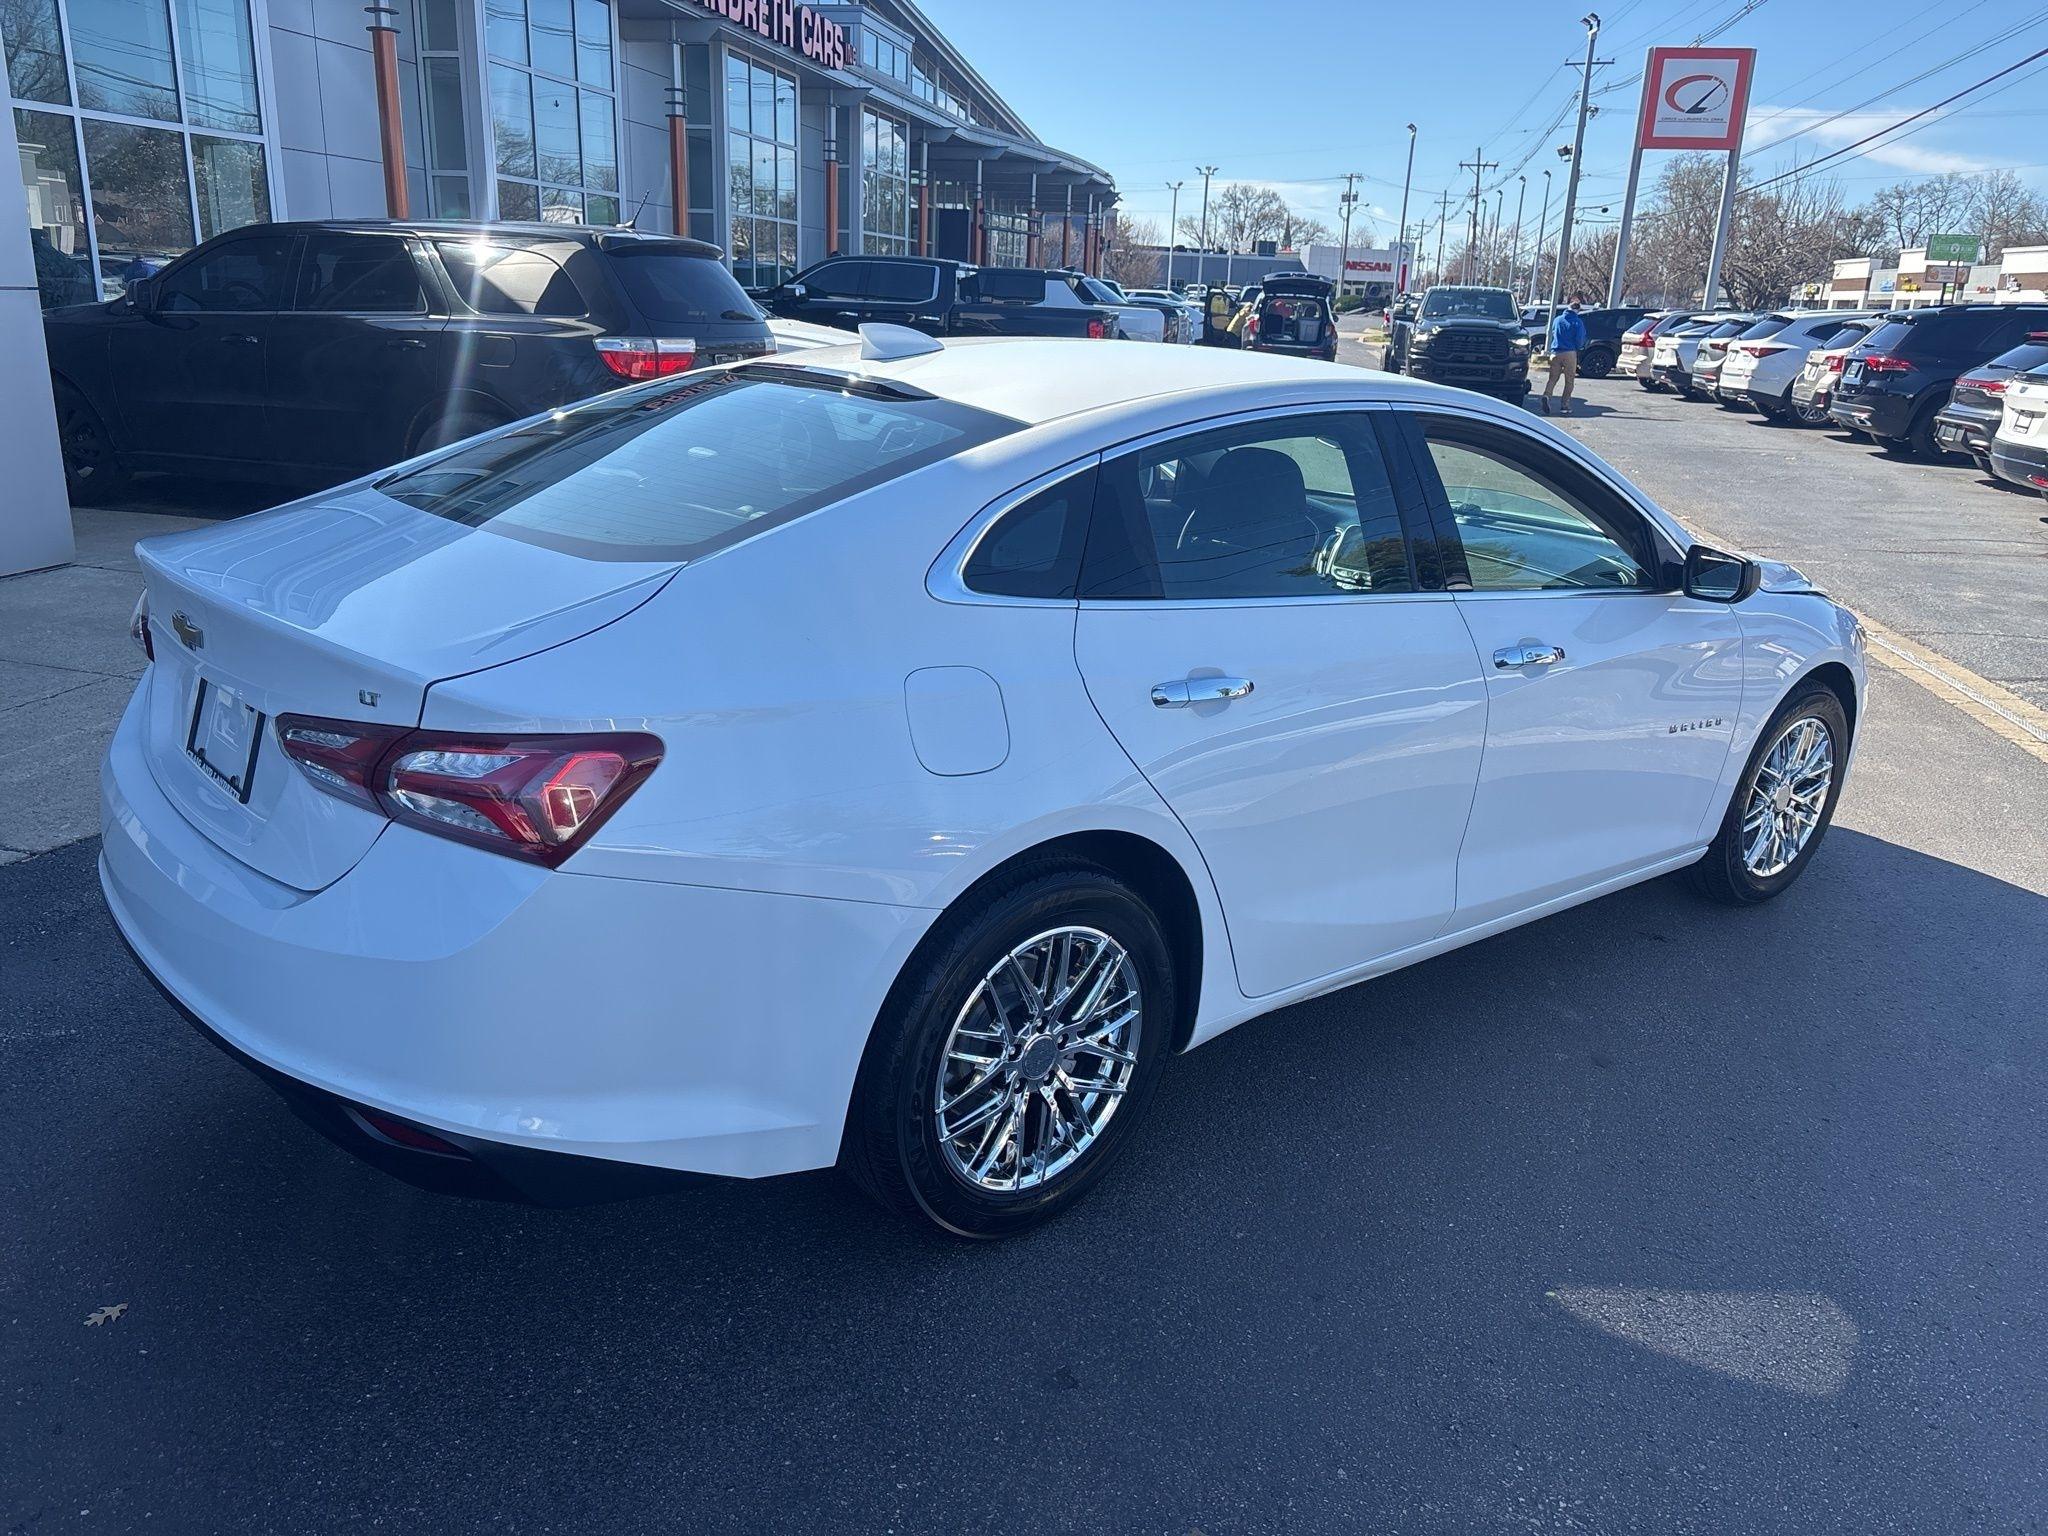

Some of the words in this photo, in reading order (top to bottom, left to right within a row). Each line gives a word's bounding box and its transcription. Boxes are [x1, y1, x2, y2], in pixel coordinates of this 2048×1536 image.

[695, 0, 795, 48] RETH
[801, 6, 845, 71] CARS
[1345, 260, 1392, 272] NISSAN
[358, 689, 381, 707] LT
